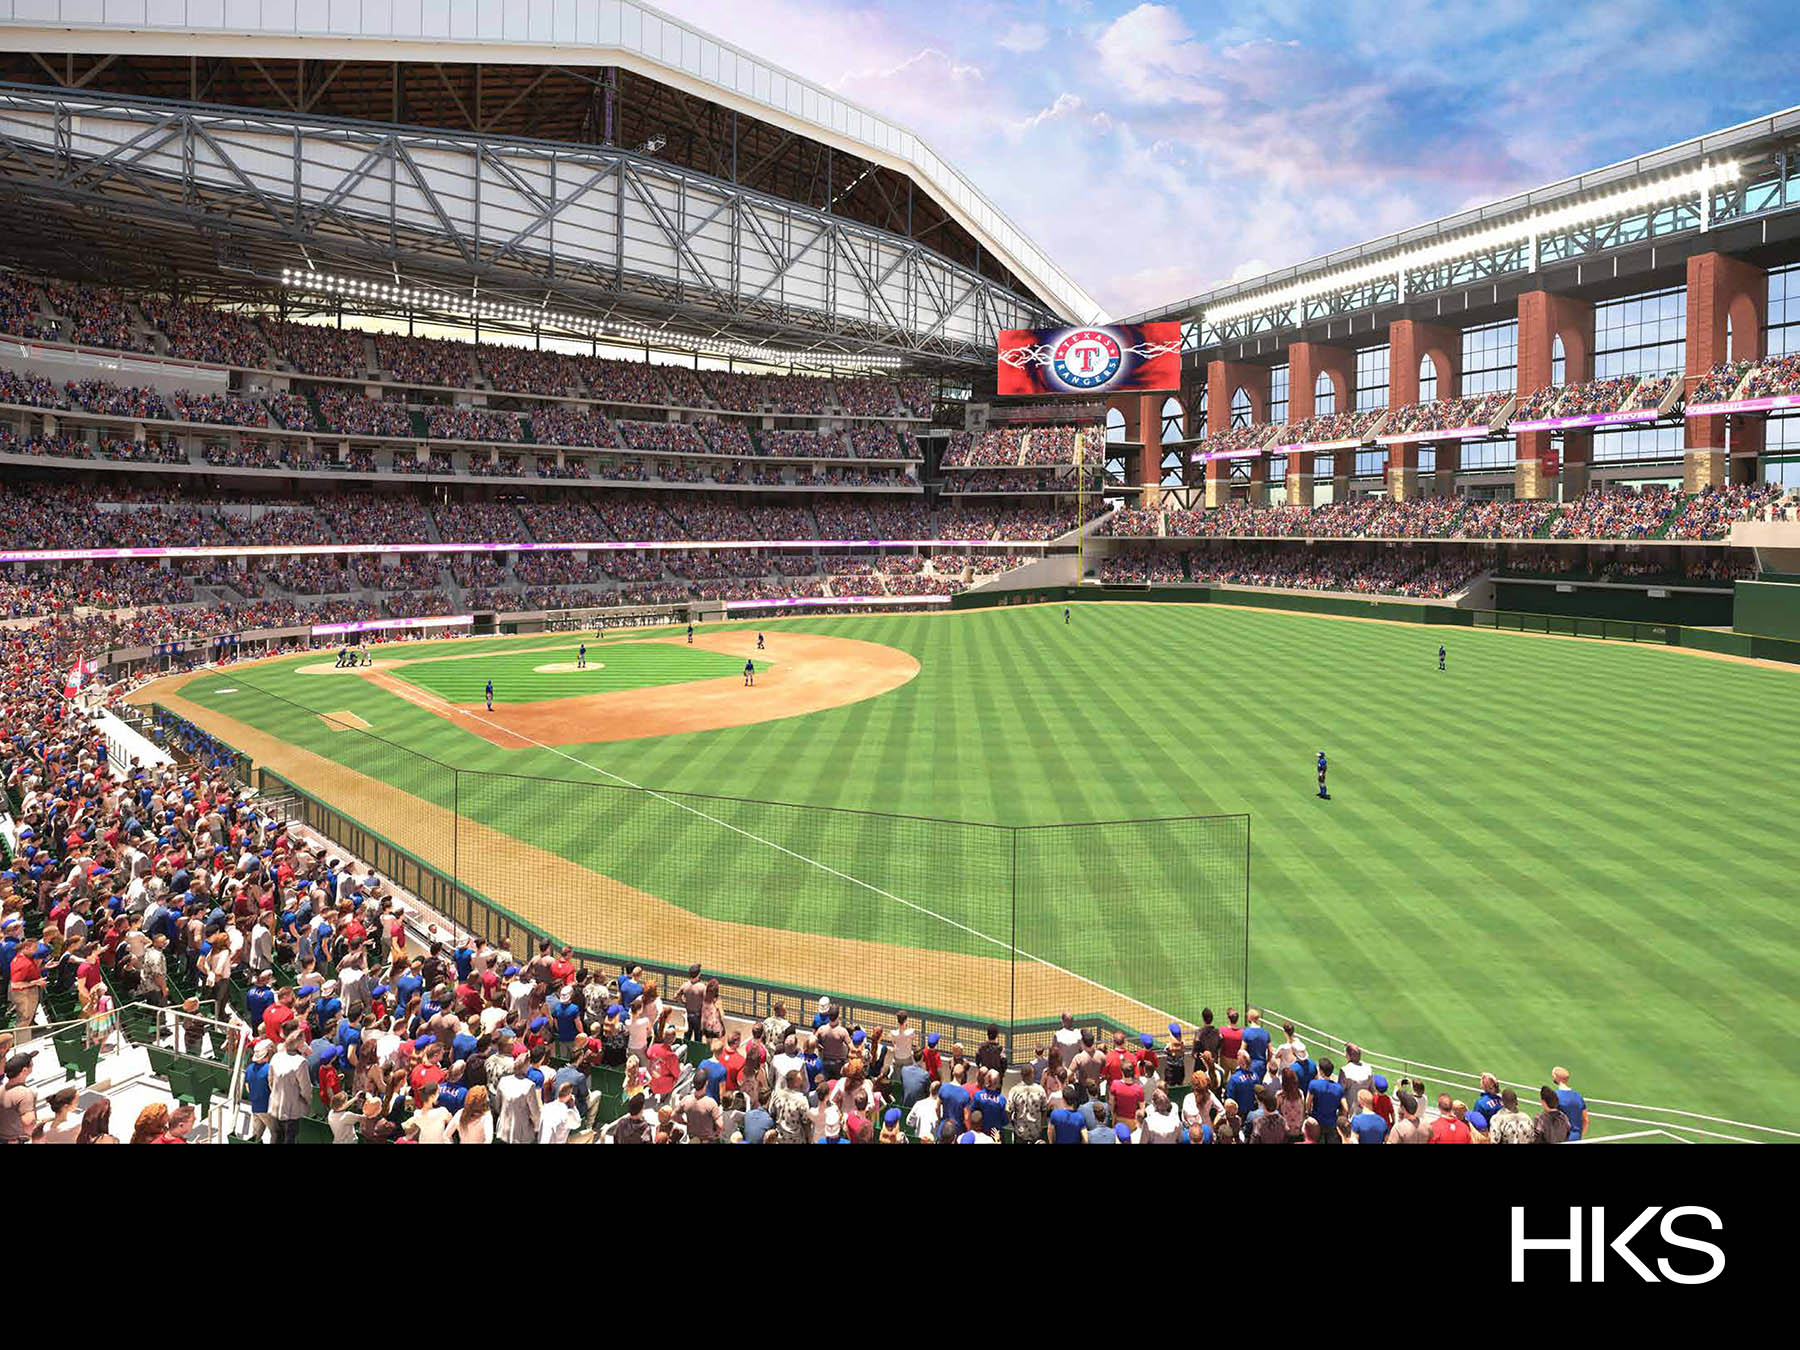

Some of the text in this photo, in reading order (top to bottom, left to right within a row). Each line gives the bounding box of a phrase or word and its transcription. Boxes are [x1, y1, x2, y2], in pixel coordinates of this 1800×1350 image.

[1062, 332, 1112, 347] TEXAS
[1075, 347, 1099, 372] T
[1057, 362, 1117, 385] RANGERS
[439, 1085, 460, 1098] TEXAS
[979, 1092, 1001, 1104] TEXAS
